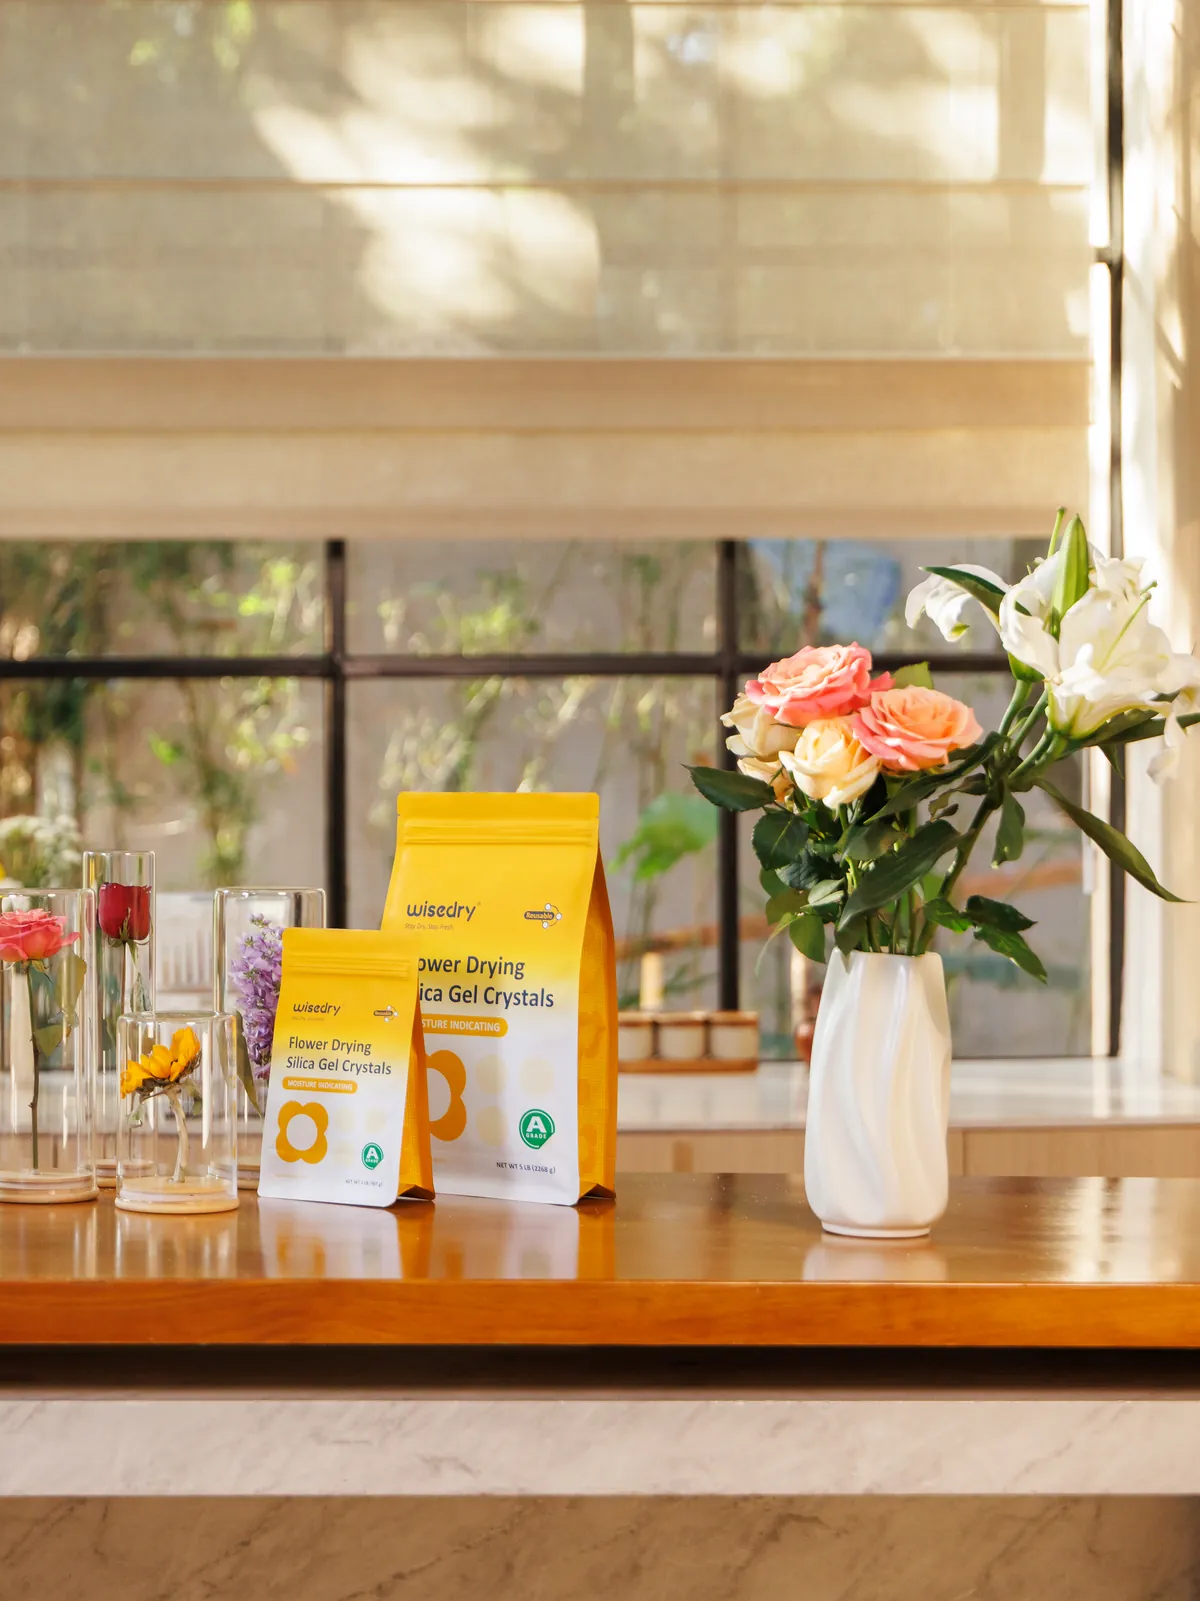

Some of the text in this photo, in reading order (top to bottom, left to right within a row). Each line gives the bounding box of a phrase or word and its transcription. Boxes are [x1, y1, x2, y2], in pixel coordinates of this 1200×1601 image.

[407, 901, 476, 922] wisedry
[526, 912, 553, 920] Reusable
[466, 956, 525, 980] Drying
[448, 984, 478, 1004] Gel
[484, 986, 554, 1009] Crystals
[293, 1002, 341, 1016] wisedry
[450, 1020, 500, 1032] INDICATING
[289, 1036, 372, 1056] Flower Drying
[286, 1056, 392, 1076] Silica Gel Crystals
[287, 1080, 353, 1091] MOISTURE INDICATING
[526, 1116, 547, 1133] A
[366, 1147, 379, 1158] A
